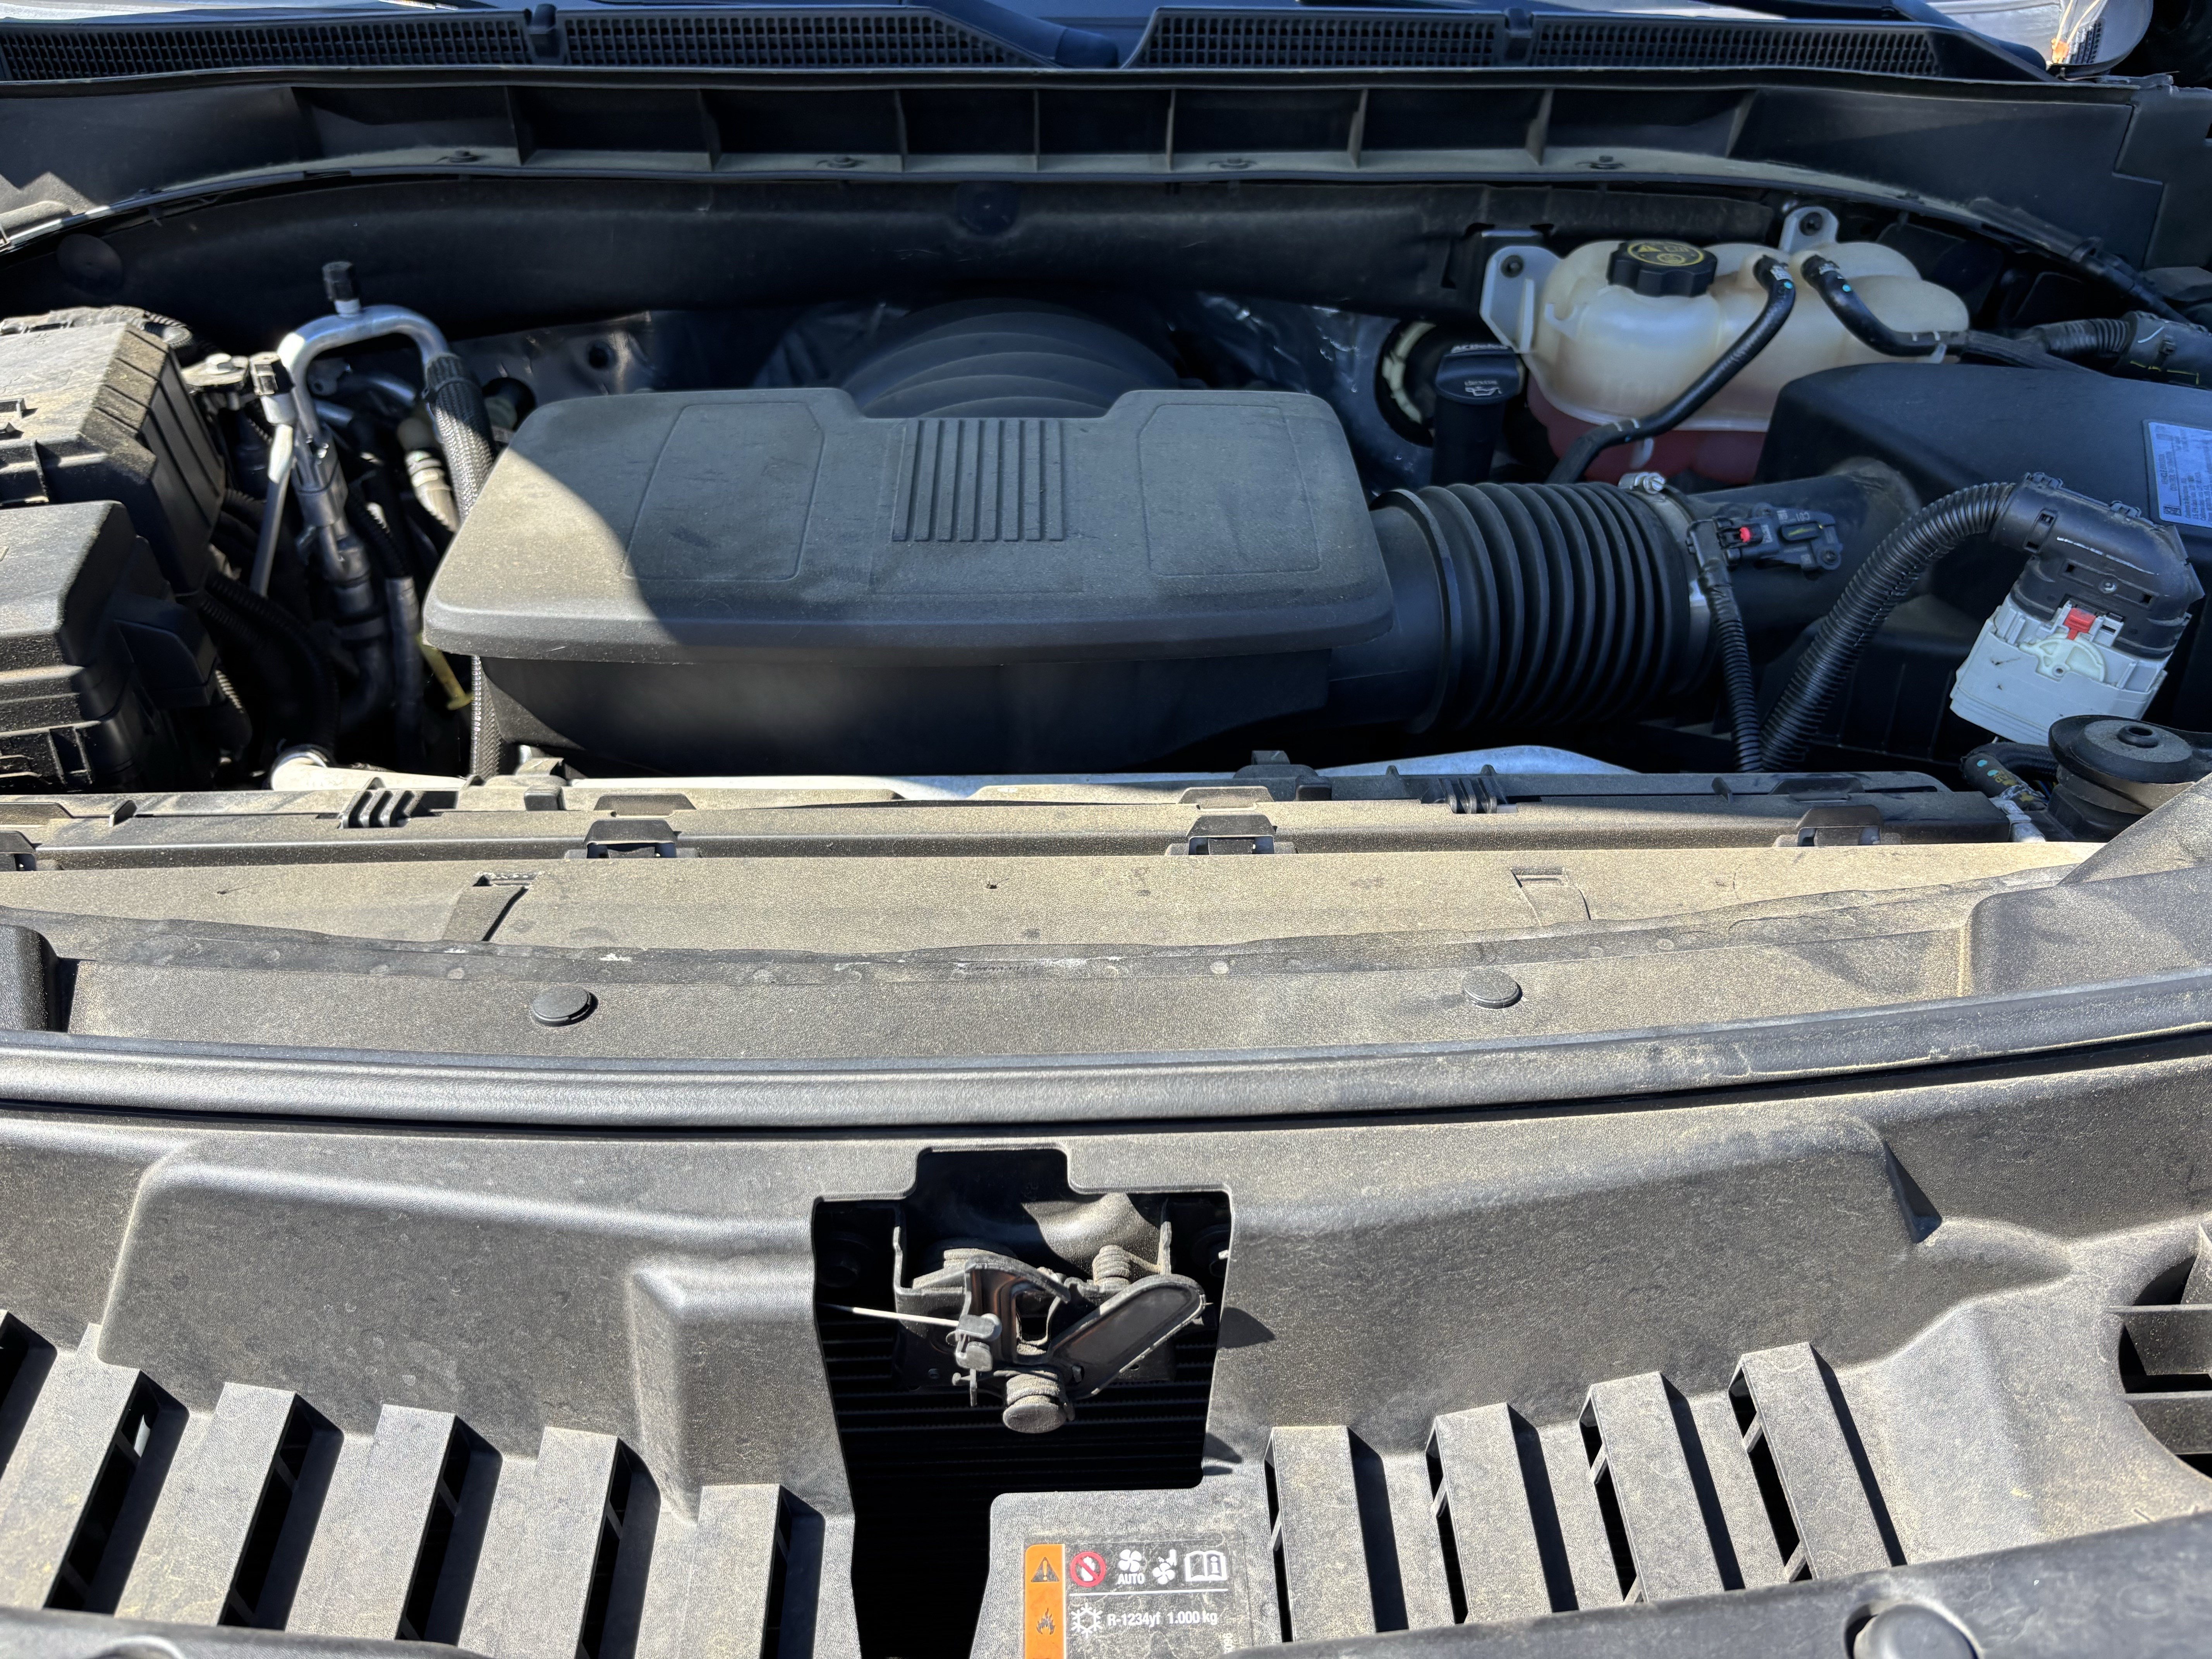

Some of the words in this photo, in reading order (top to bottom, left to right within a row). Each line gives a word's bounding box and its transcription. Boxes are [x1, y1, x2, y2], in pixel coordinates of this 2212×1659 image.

[1117, 1573, 1145, 1585] AUTO
[1107, 1611, 1161, 1627] R-1234yf
[1167, 1611, 1200, 1624] 1.000
[1202, 1611, 1218, 1626] kg
